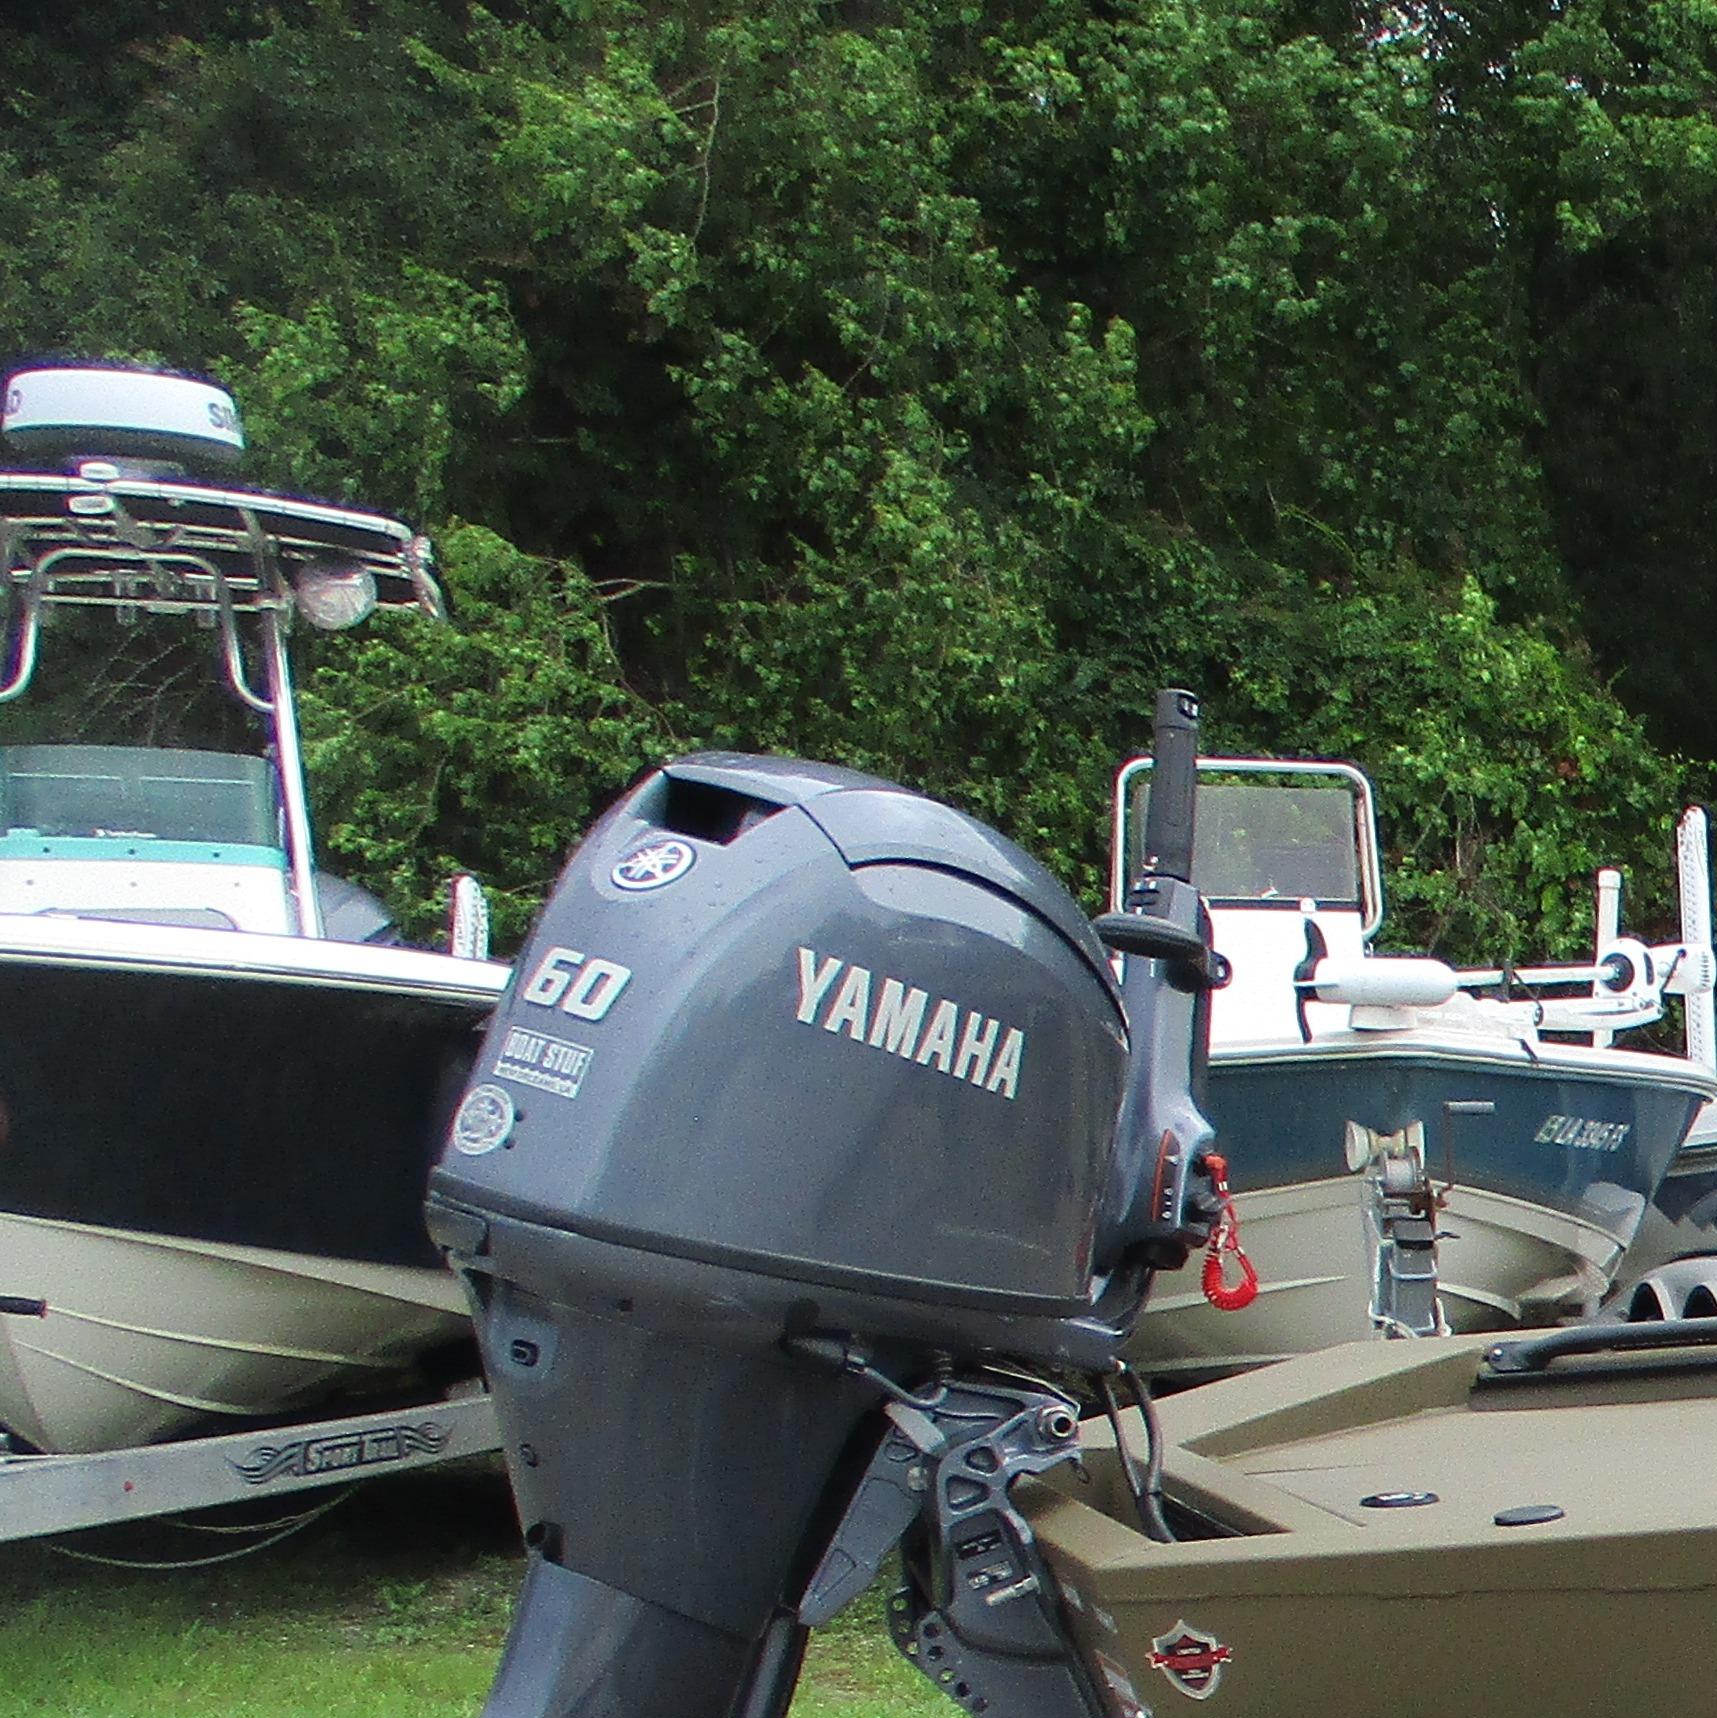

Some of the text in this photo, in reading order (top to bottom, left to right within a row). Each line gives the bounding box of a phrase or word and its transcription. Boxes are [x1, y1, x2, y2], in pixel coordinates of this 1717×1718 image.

[523, 945, 633, 1023] 60
[795, 945, 1026, 1100] YAMAHA
[540, 1044, 587, 1076] STUF
